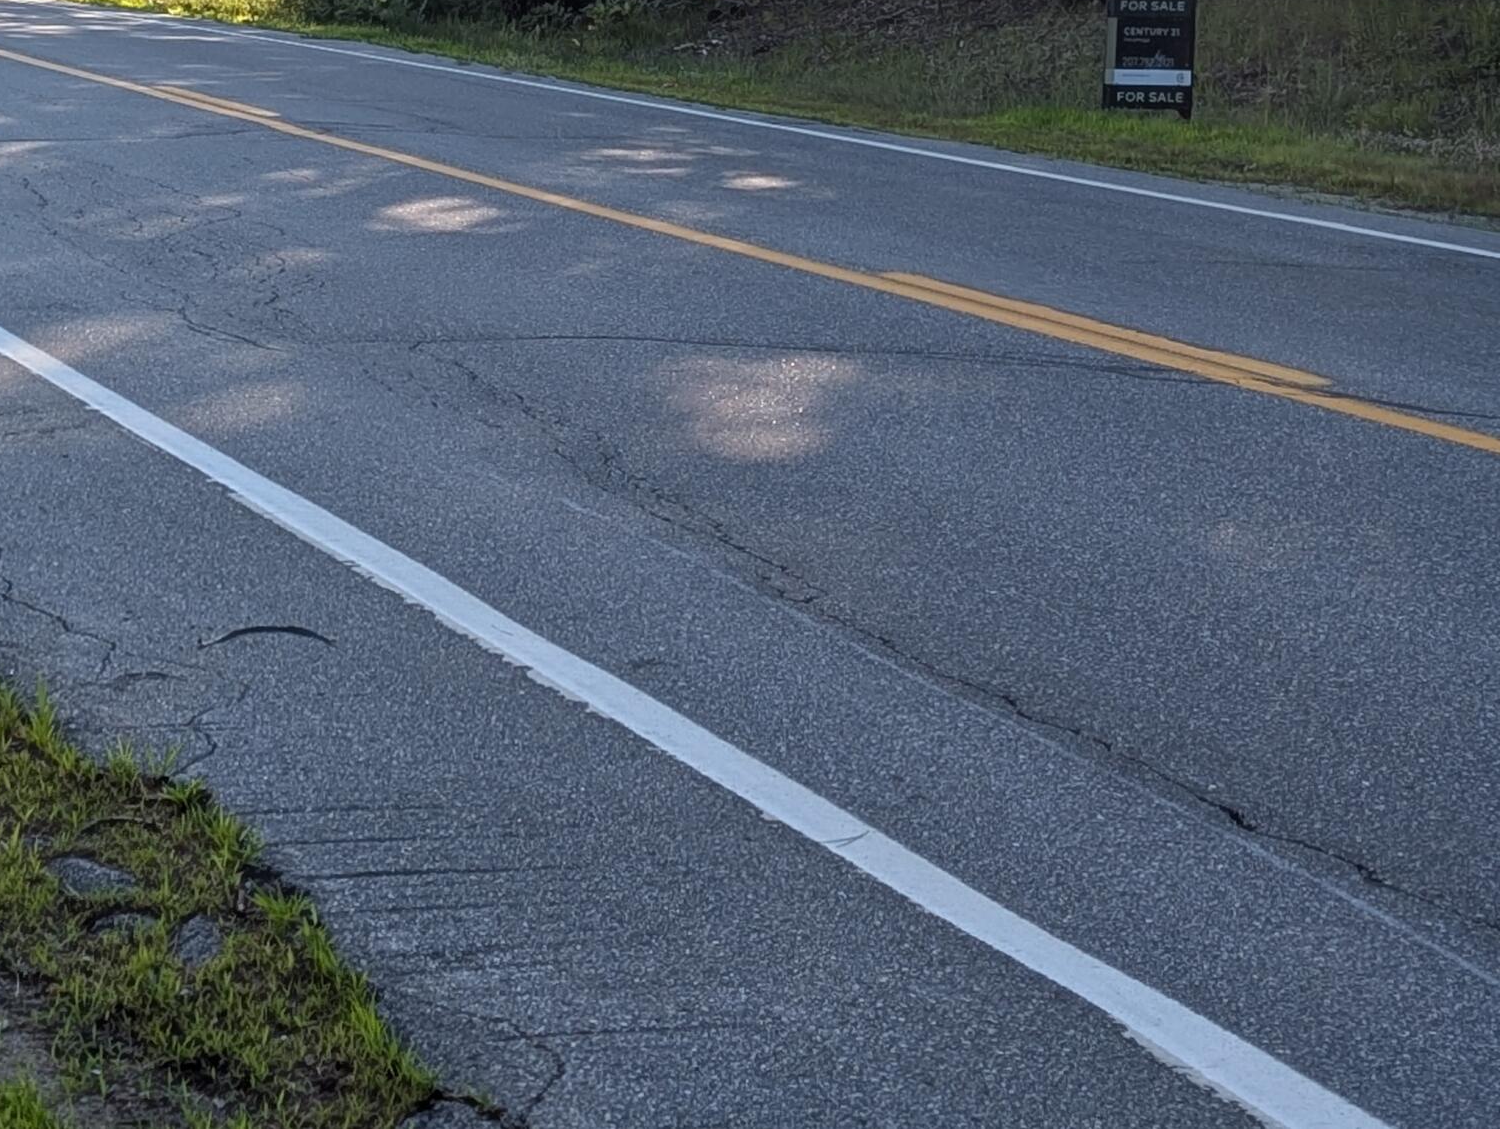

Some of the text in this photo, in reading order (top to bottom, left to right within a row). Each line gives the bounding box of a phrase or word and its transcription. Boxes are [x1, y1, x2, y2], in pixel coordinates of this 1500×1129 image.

[1120, 0, 1185, 12] FOR SALE
[1124, 27, 1169, 36] CENTURY
[1117, 91, 1184, 103] FOR SALE
